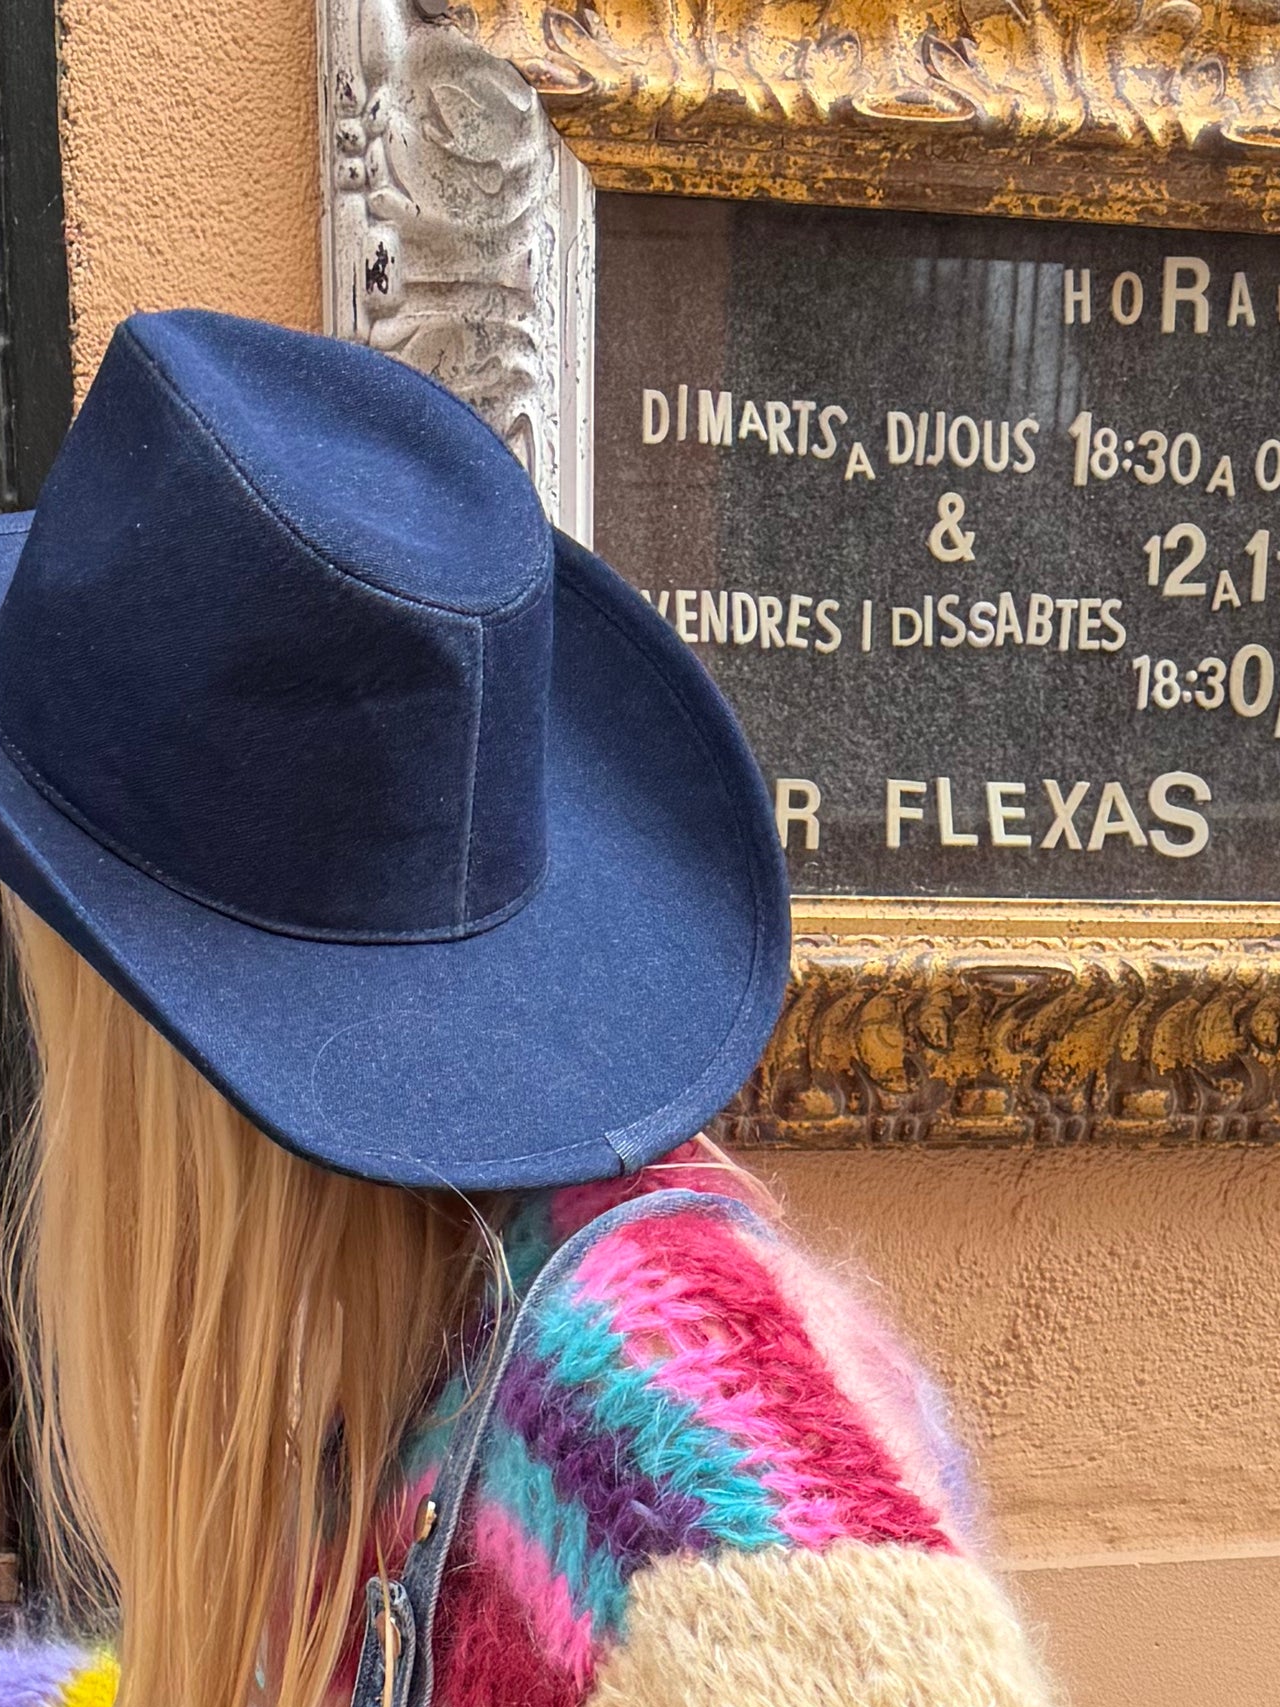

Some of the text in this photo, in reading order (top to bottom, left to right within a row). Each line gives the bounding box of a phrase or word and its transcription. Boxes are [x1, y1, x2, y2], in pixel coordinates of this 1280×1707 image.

[642, 384, 848, 459] DIMARTS
[844, 441, 876, 481] A
[887, 410, 1040, 473] DIJOUS
[1068, 411, 1202, 487] 18:30
[1205, 455, 1236, 497] A
[927, 491, 976, 562] &
[1142, 522, 1207, 596] 12
[1211, 570, 1242, 612] A
[861, 600, 872, 652] I
[891, 591, 1127, 652] DISSABTES
[1132, 643, 1275, 718] 18:30
[885, 770, 1212, 858] FLEXAS
